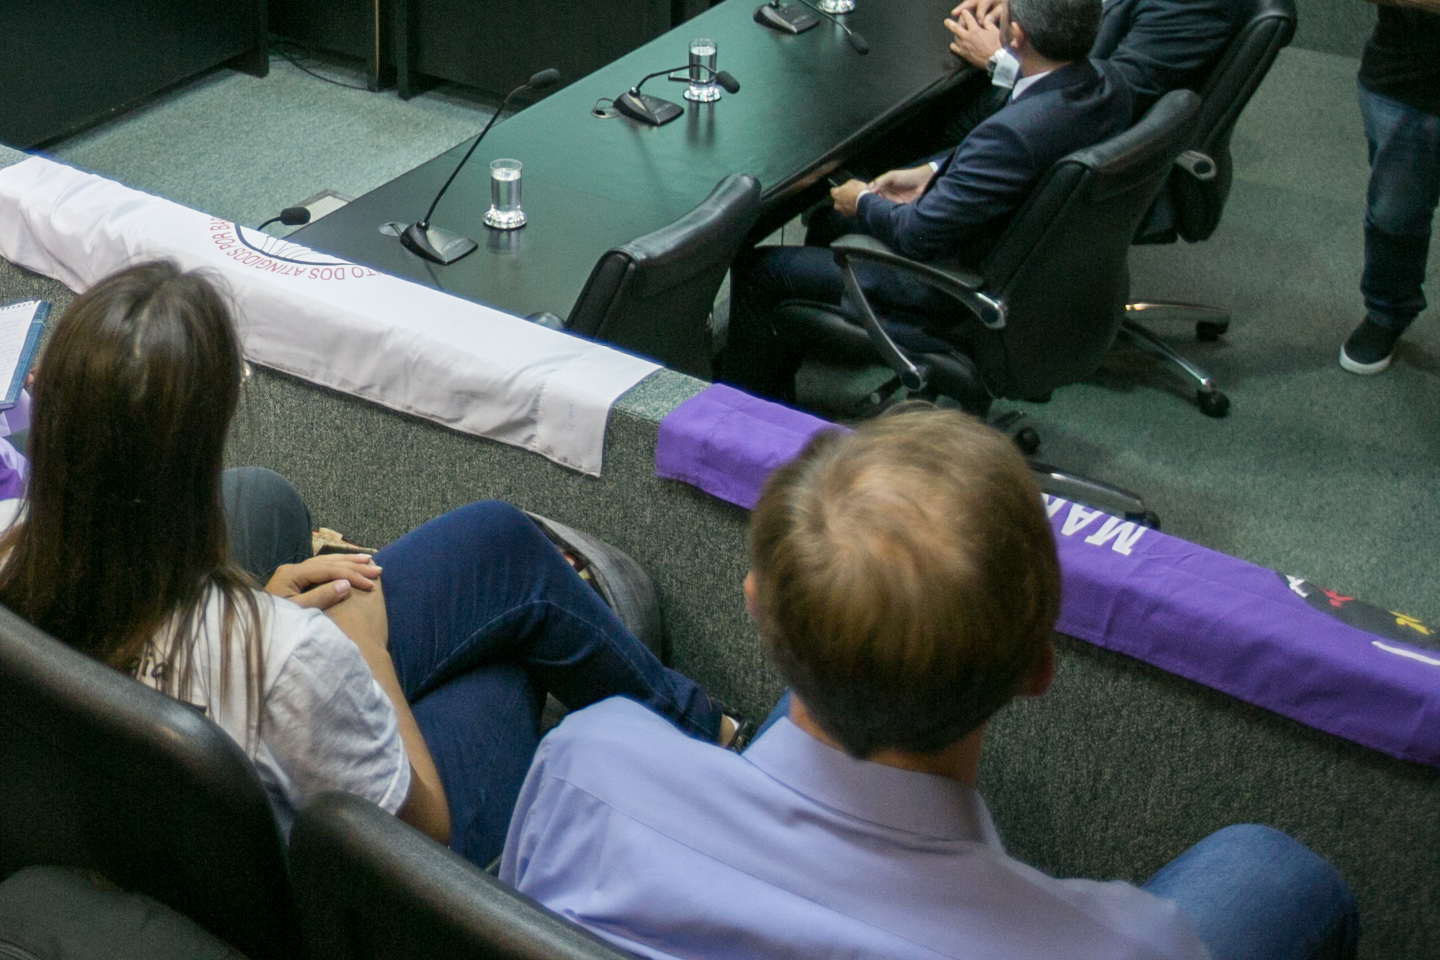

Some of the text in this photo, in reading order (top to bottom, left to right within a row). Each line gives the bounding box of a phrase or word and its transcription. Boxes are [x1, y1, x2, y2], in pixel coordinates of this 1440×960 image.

[212, 232, 239, 250] POR
[226, 248, 307, 276] ATINGIDOS
[308, 267, 345, 280] DOS
